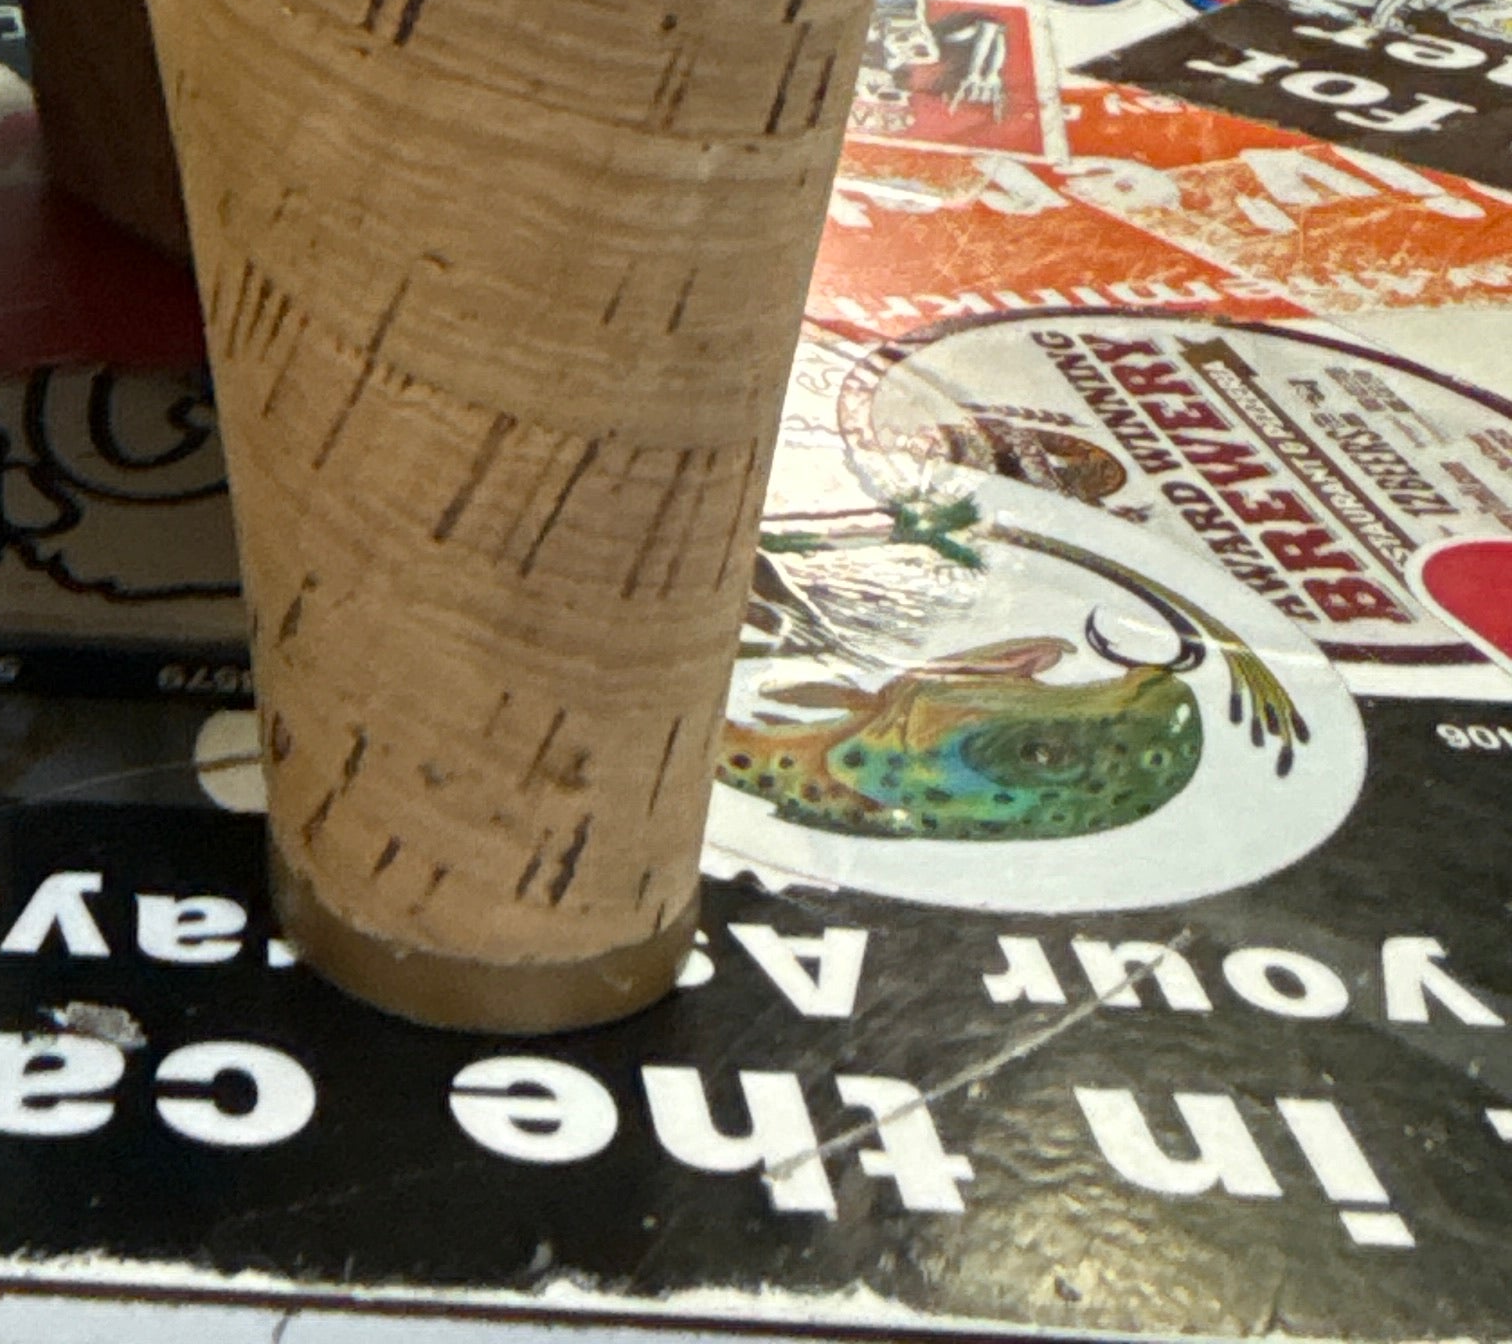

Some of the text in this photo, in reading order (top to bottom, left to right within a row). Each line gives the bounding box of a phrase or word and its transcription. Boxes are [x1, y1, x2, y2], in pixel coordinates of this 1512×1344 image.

[1187, 49, 1477, 132] for
[1030, 331, 1320, 622] AWARD WINNING
[1077, 333, 1410, 624] BREWERY
[982, 932, 1504, 1028] your
[448, 1055, 975, 1221] the
[1073, 1085, 1416, 1248] in
